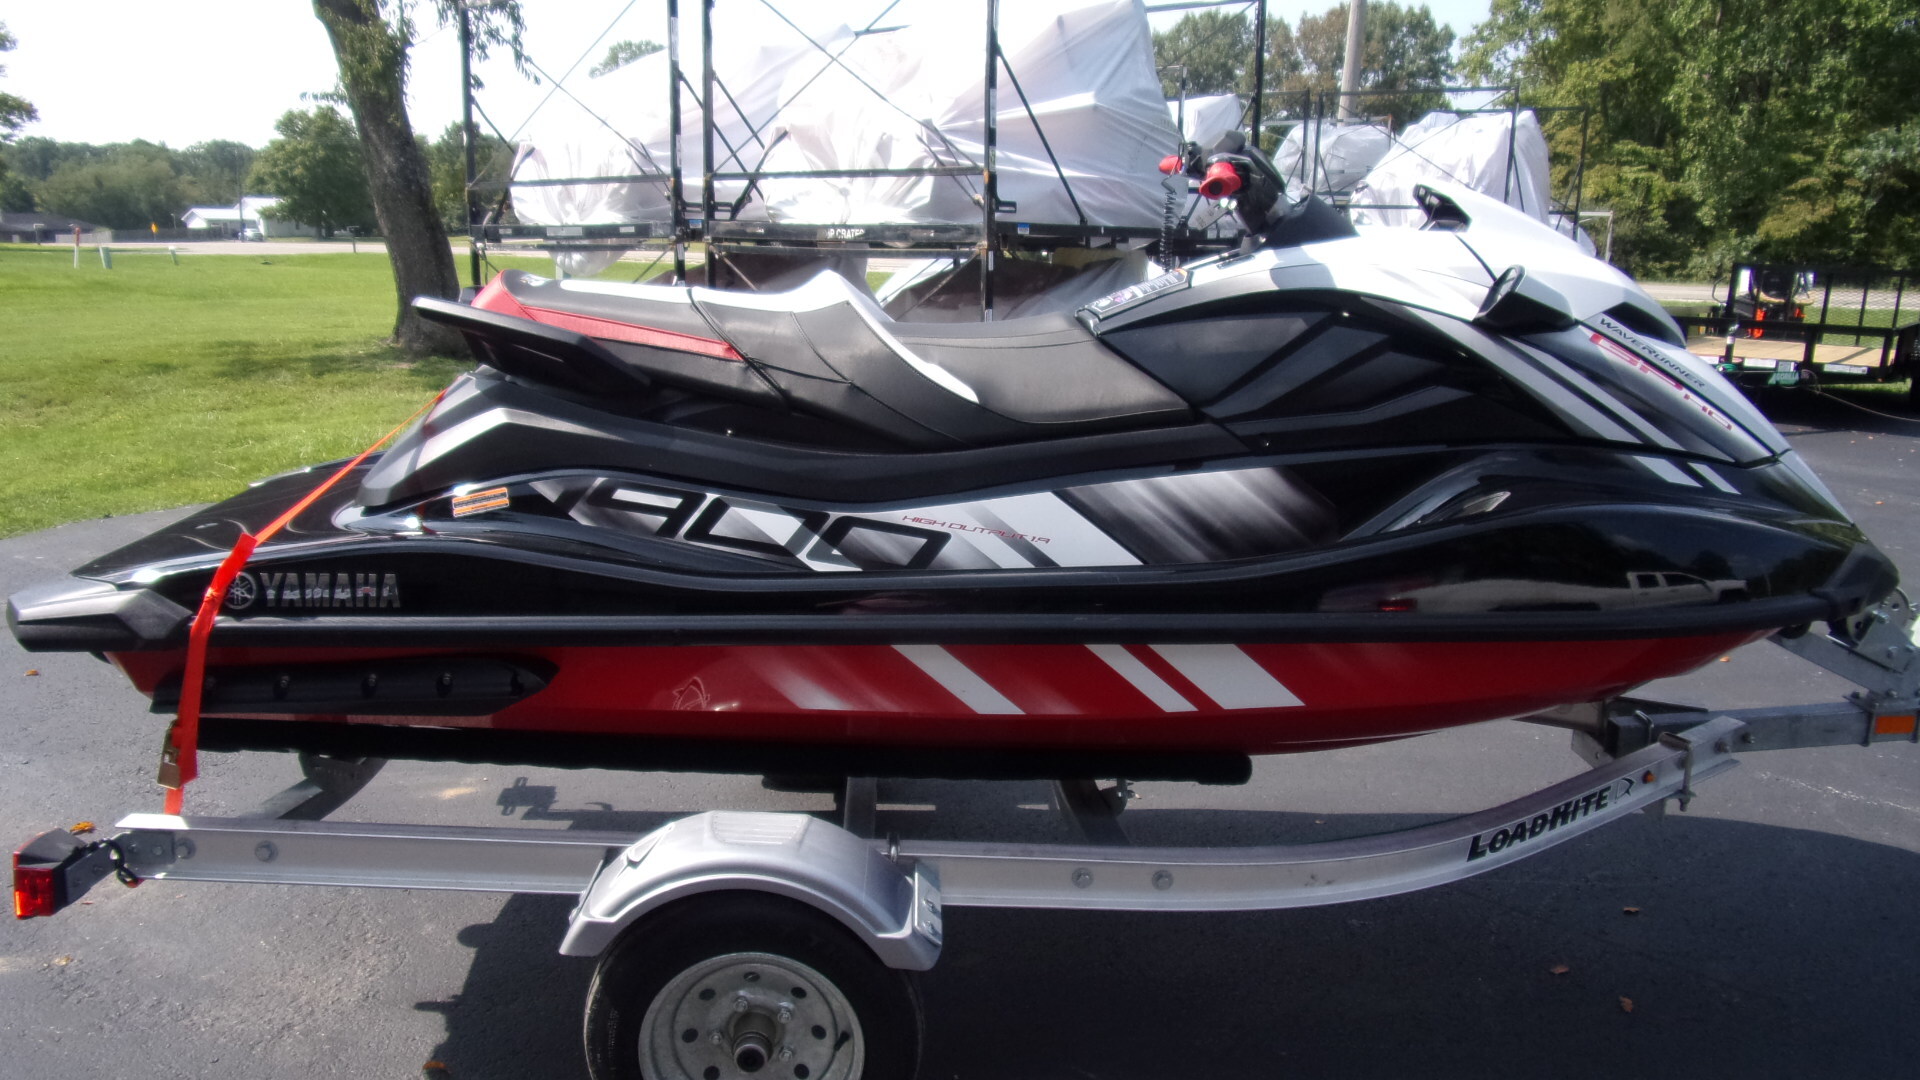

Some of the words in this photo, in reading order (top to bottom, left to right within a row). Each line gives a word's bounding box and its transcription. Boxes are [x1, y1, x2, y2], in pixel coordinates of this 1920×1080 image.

[1600, 317, 1706, 387] WAVERUNNER
[902, 515, 946, 527] HIGH
[949, 522, 1027, 539] OUTPUT
[259, 572, 401, 608] YAMAHA
